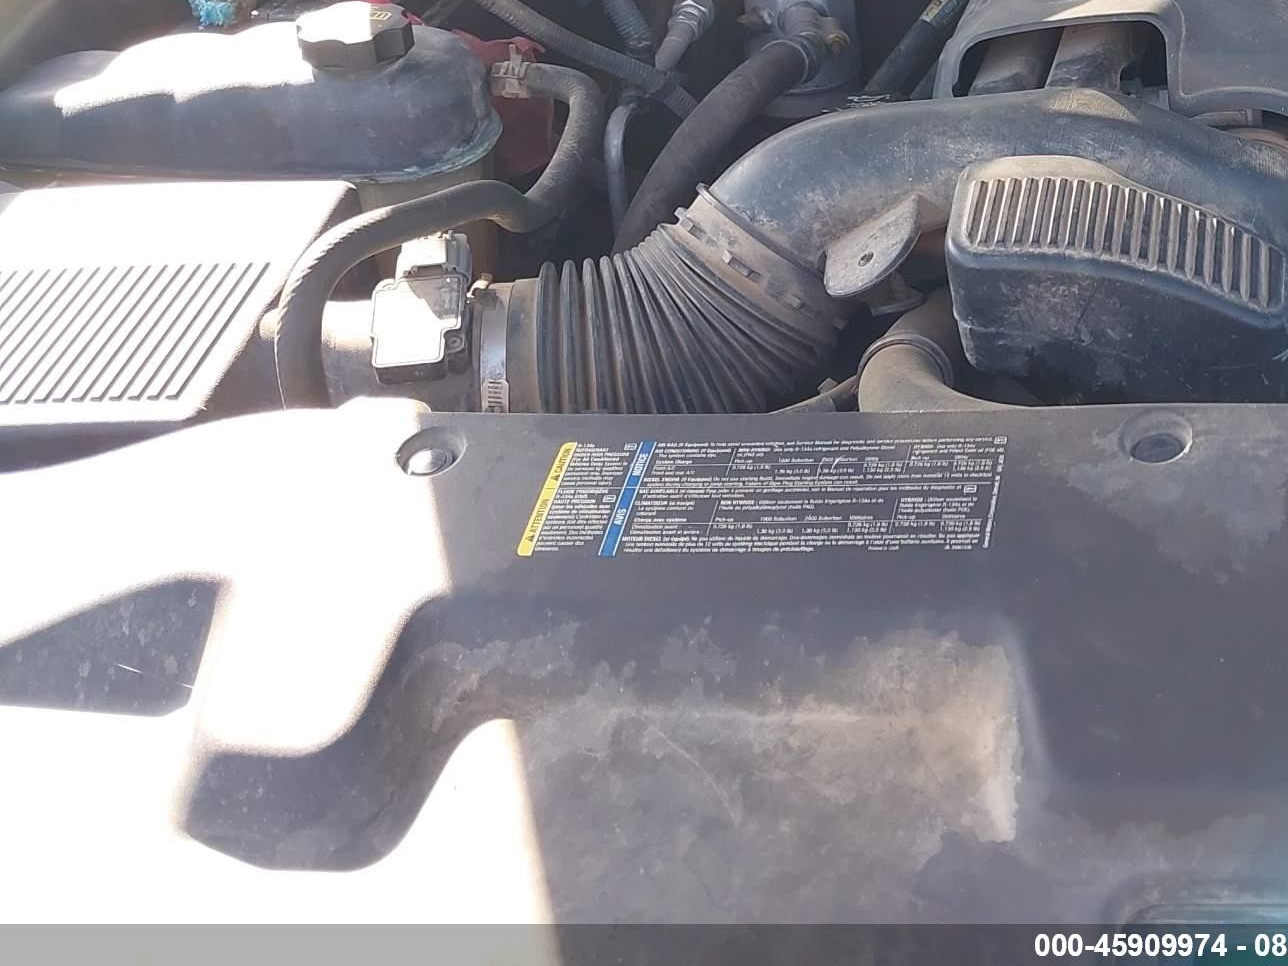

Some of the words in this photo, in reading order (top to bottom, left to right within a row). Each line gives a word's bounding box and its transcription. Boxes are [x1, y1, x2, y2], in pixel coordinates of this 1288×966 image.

[556, 448, 573, 474] CAUTION
[632, 453, 648, 476] NOTICE
[530, 499, 549, 533] ATTENTION
[614, 508, 627, 526] AVIS
